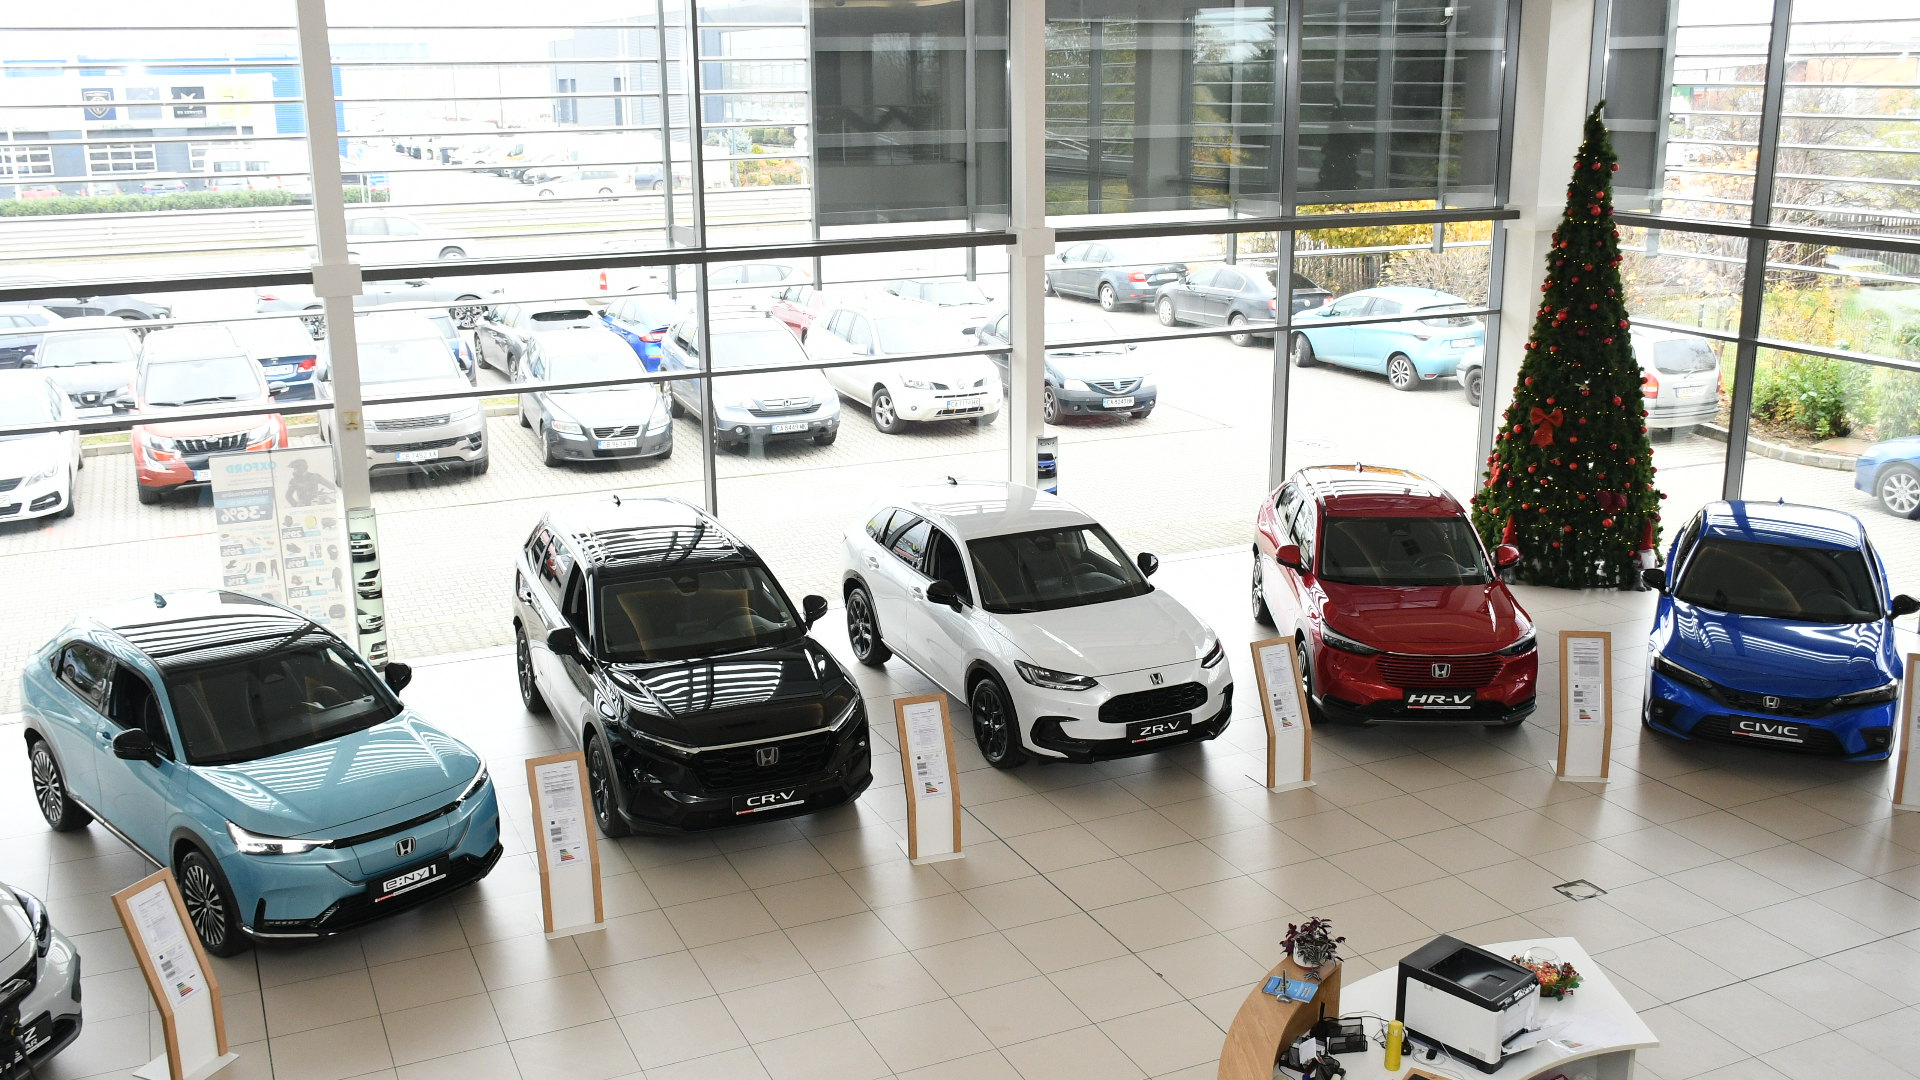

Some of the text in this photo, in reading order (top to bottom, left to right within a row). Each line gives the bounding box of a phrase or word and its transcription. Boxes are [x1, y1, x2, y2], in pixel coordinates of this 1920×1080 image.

[1407, 694, 1472, 704] HR-V
[1140, 720, 1180, 736] ZR-V
[1739, 721, 1799, 737] CIVIC
[746, 789, 795, 806] CR-V
